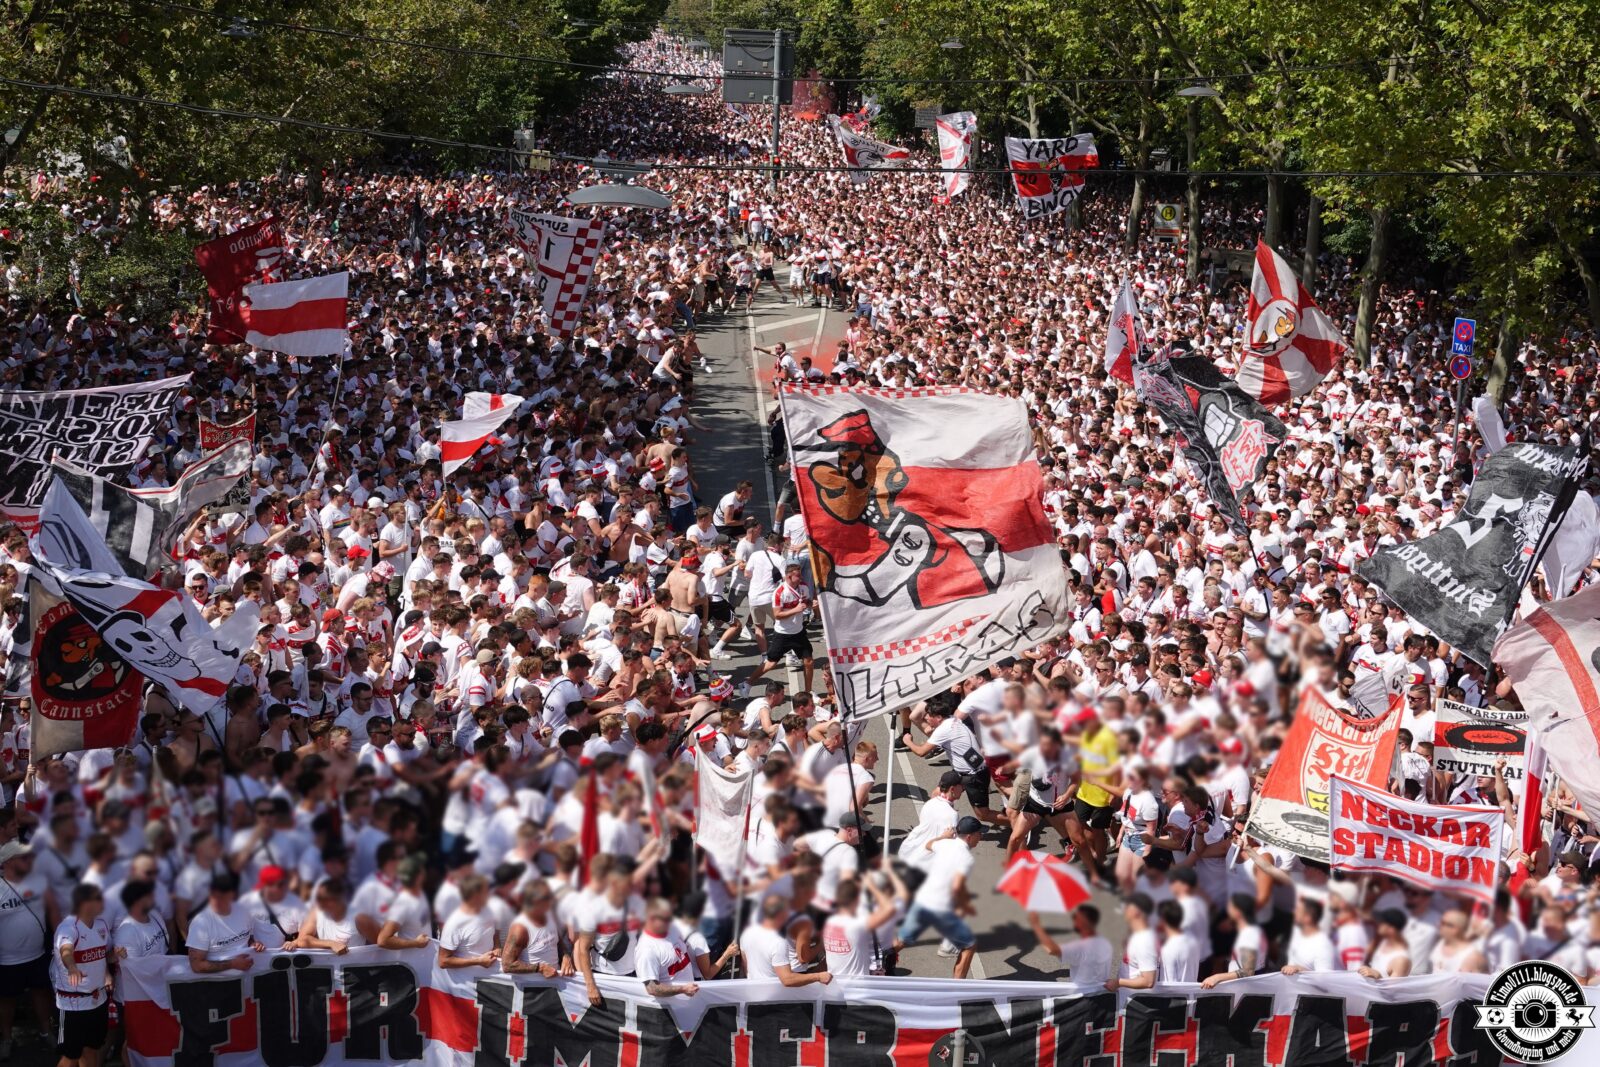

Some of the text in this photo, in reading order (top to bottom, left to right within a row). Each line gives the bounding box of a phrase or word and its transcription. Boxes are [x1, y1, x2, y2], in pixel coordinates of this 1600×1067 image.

[1022, 137, 1078, 160] YARD
[1455, 342, 1471, 353] TAXI
[41, 688, 132, 718] Cannstatt
[1443, 701, 1529, 720] NECKARSTADI
[1341, 791, 1491, 848] NECKAR
[1333, 828, 1496, 887] STADION
[168, 955, 423, 1067] FÜR
[474, 977, 898, 1067] IMMER
